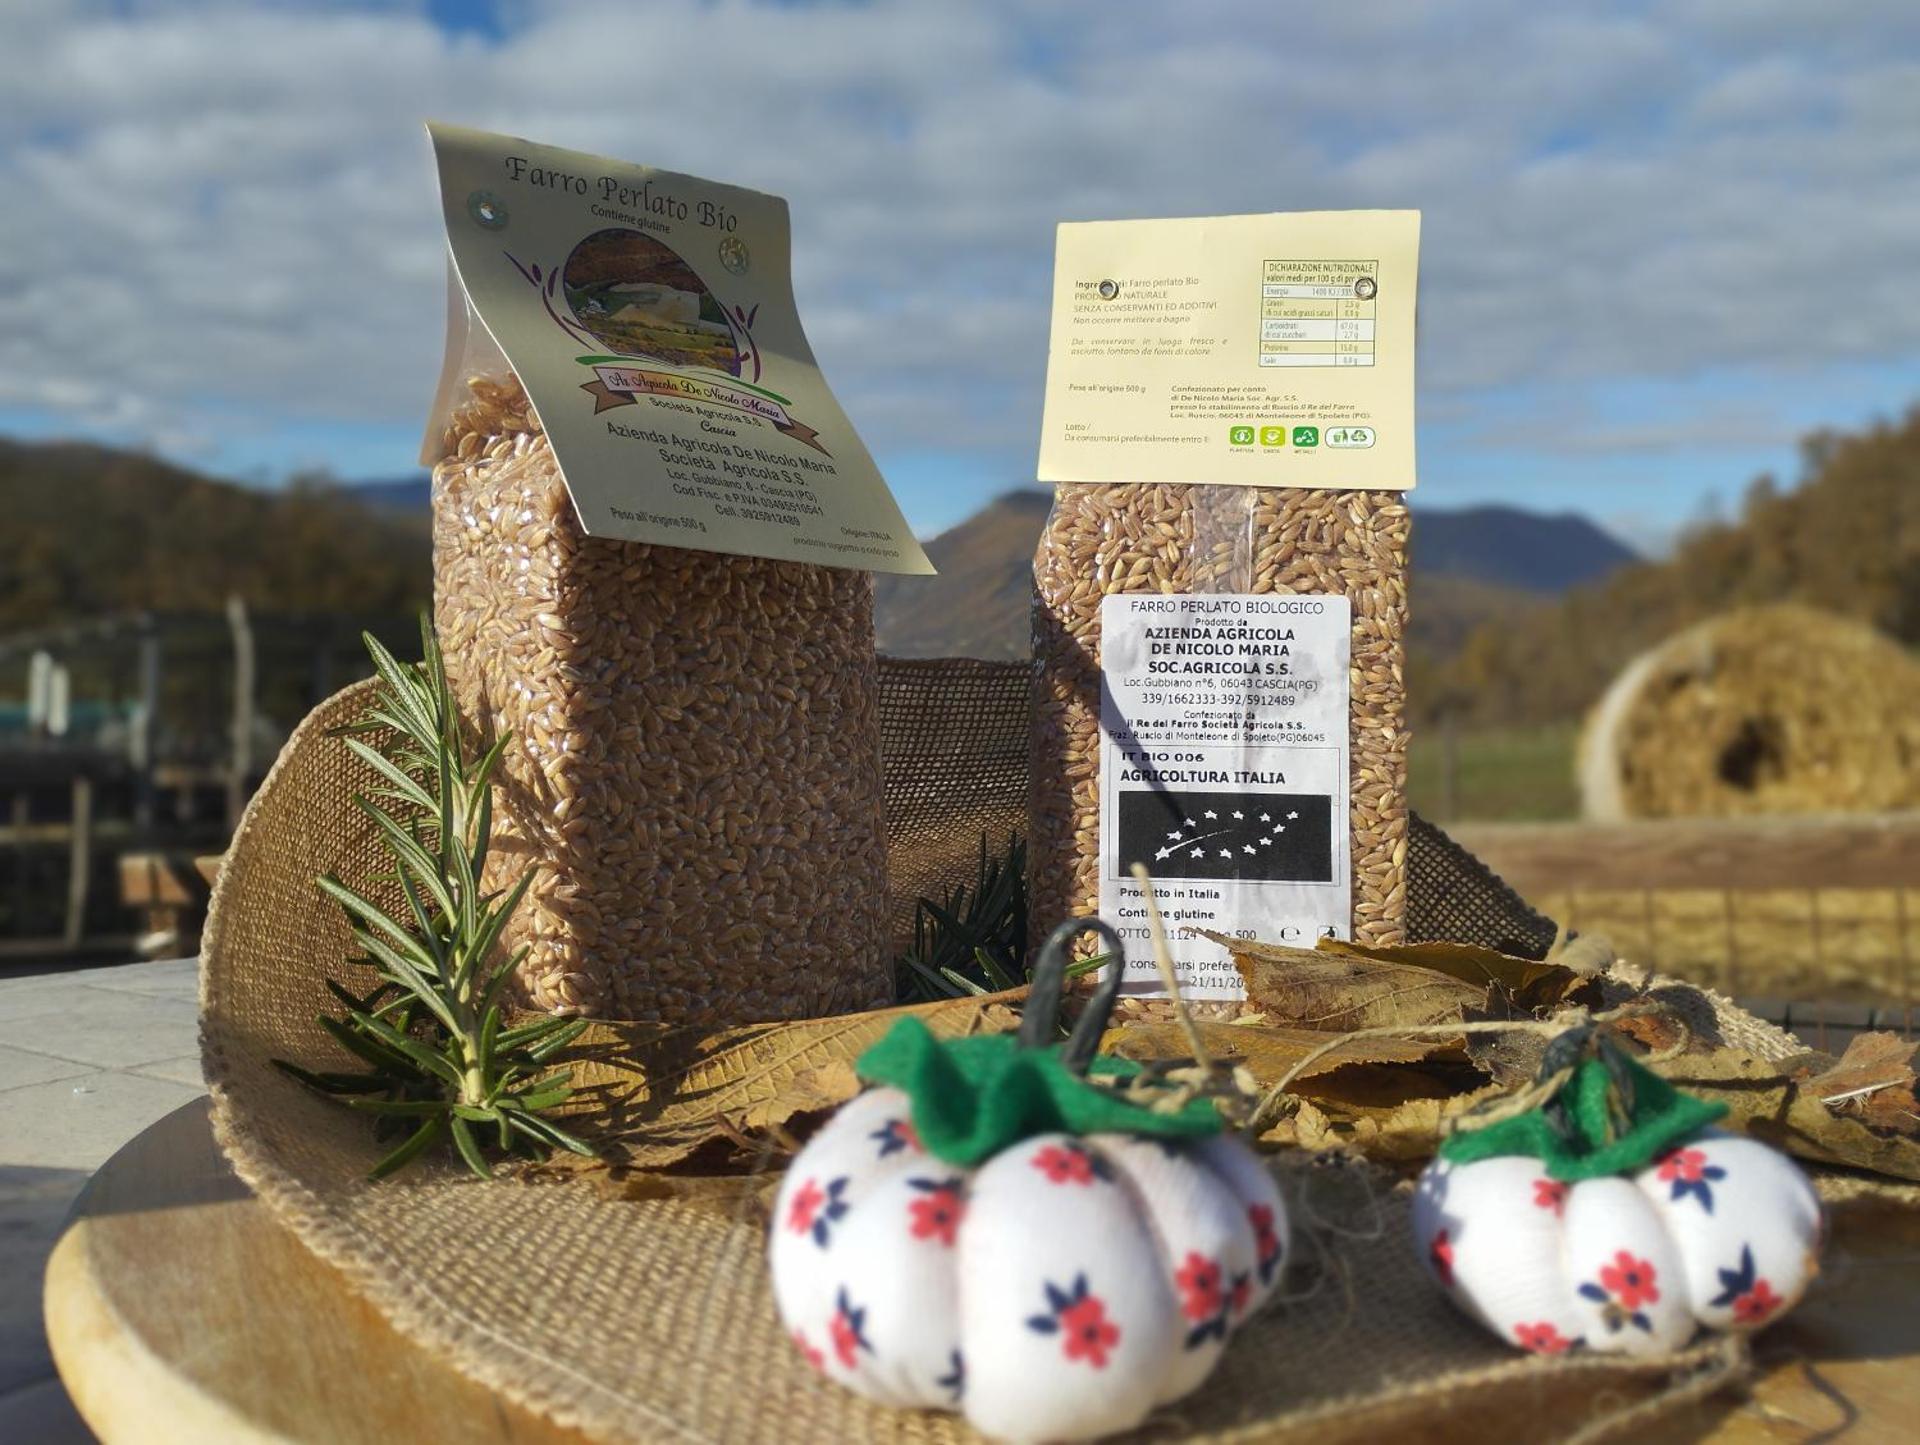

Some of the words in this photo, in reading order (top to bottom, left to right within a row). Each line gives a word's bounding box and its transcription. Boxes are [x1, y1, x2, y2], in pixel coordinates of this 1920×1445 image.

[505, 156, 587, 195] Farro
[598, 176, 687, 221] Perlato
[697, 201, 737, 232] Bio
[591, 204, 636, 225] Contiene
[637, 215, 671, 234] glutine
[1269, 263, 1321, 272] DICHIARAZIONE
[1323, 263, 1373, 272] NUTRIZIONALE
[1130, 279, 1150, 287] Farro
[1153, 279, 1183, 289] perlato
[1185, 277, 1199, 285] Bio
[1287, 274, 1303, 282] medi
[1336, 274, 1343, 282] di
[1124, 291, 1168, 299] NATURALE
[1074, 305, 1101, 313] SENZA
[1104, 303, 1163, 312] CONSERVANTI
[1179, 302, 1217, 310] ADDITIVI
[1073, 317, 1089, 325] Non
[1123, 316, 1154, 324] mettere
[1163, 315, 1190, 324] bagno
[1159, 338, 1182, 347] luogo
[1107, 347, 1139, 355] lontano
[1141, 347, 1152, 355] da
[1171, 385, 1224, 393] Confezionato
[1227, 386, 1241, 394] per
[681, 382, 701, 395] De
[704, 386, 738, 405] Nicolo
[741, 400, 780, 419] Maria
[696, 406, 741, 422] Agricola
[1318, 412, 1349, 420] Spoleto
[700, 420, 737, 437] Cascia
[1076, 434, 1119, 442] consumarsi
[1120, 435, 1179, 444] preferibilmente
[607, 422, 668, 444] Azienda
[671, 433, 731, 457] Agricola
[733, 445, 752, 460] De
[756, 448, 797, 468] Nicolo
[799, 458, 837, 475] Maria
[658, 449, 716, 471] Società
[723, 460, 780, 482] Agricola
[781, 470, 810, 486] S.S.
[761, 483, 793, 499] Cascia
[1131, 601, 1176, 613] FARRO
[1180, 601, 1241, 613] PERLATO
[1246, 601, 1324, 614] BIOLOGICO
[1195, 617, 1234, 627] Prodotto
[1236, 618, 1248, 627] da
[1145, 628, 1212, 640] AZIENDA
[1216, 628, 1295, 641] AGRICOLA
[1151, 643, 1172, 655] DE
[1176, 643, 1234, 656] NICOLO
[1239, 644, 1290, 657] MARIA
[1148, 661, 1260, 675] SOC.AGRICOLA
[1265, 663, 1293, 676] S.S.
[1124, 677, 1192, 688] Loc.Gubbiano
[1220, 678, 1254, 689] 06043
[1255, 679, 1318, 691] CASCIA(PG)
[1183, 710, 1242, 720] Confezionato
[1246, 710, 1256, 720] da
[1136, 719, 1150, 728] Re
[1153, 719, 1168, 728] del
[1171, 720, 1198, 729] Farro
[1242, 720, 1284, 731] Agricola
[1287, 721, 1306, 731] S.S.
[1133, 731, 1163, 740] Ruscio
[1166, 731, 1174, 740] di
[1176, 731, 1229, 741] Monteleone
[1231, 732, 1240, 741] di
[1122, 752, 1136, 761] IT
[1140, 752, 1169, 762] BIO
[1174, 753, 1205, 762] 006
[1120, 770, 1229, 784] AGRICOLTURA
[1234, 771, 1286, 784] ITALIA
[1174, 888, 1185, 899] in
[1189, 889, 1220, 900] Italia
[1118, 907, 1170, 919] Contine
[1174, 908, 1215, 921] glutine
[1117, 927, 1151, 939] OTTO
[1235, 930, 1257, 941] 500
[1130, 960, 1195, 970] consarsi
[1199, 960, 1233, 972] prefer
